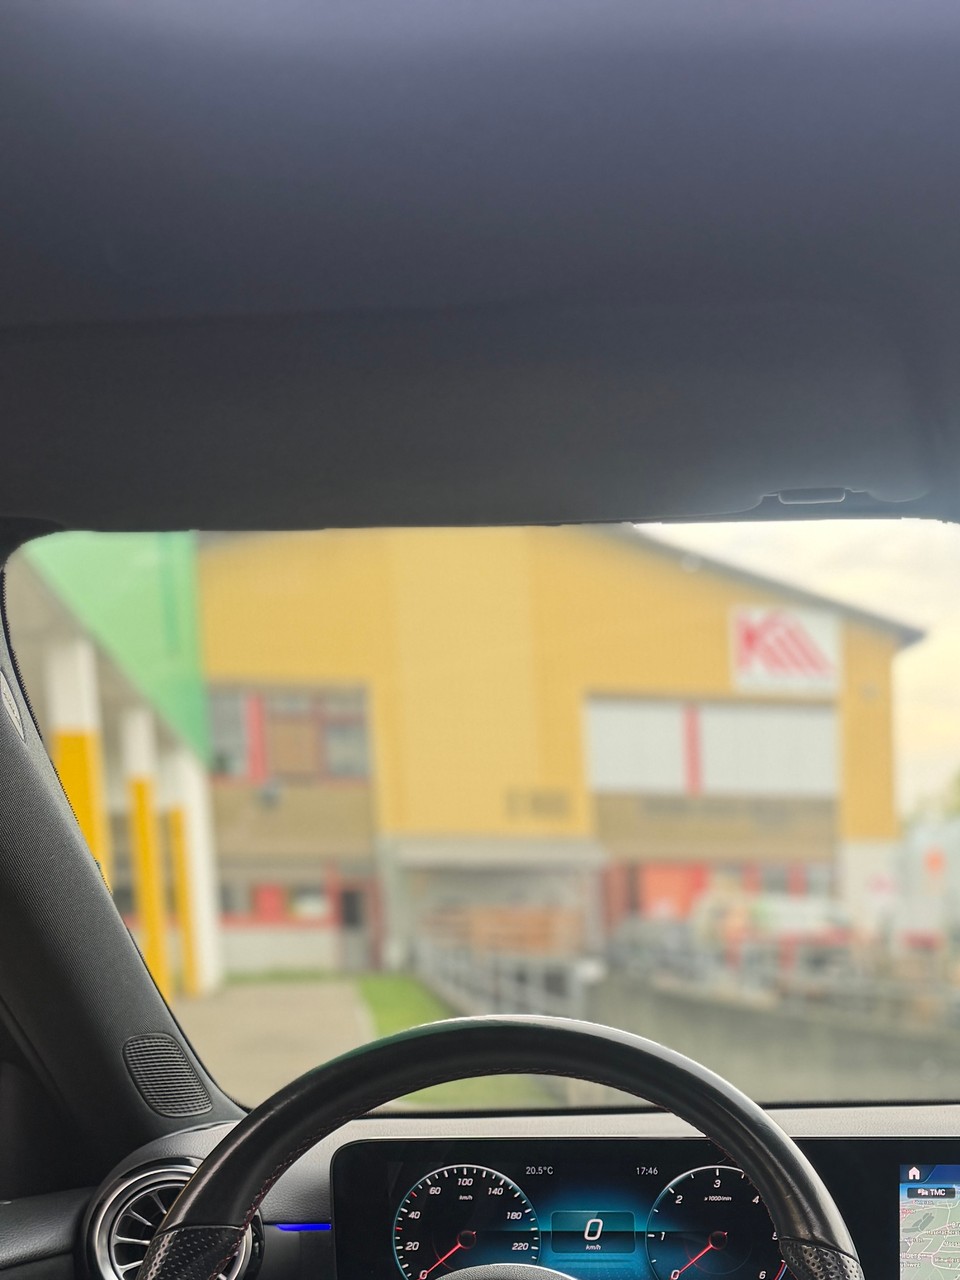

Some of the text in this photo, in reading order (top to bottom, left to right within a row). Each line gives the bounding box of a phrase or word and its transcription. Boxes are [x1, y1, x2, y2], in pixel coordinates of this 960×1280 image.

[526, 1166, 554, 1175] 20.5°C
[636, 1167, 659, 1175] 17:46
[457, 1178, 473, 1186] 100
[714, 1179, 721, 1188] 3
[429, 1187, 441, 1195] 60
[488, 1187, 503, 1195] 140
[675, 1195, 683, 1204] 2
[752, 1195, 760, 1204] 4
[408, 1211, 420, 1219] 40
[506, 1212, 522, 1220] 180
[584, 1218, 603, 1241] 0
[660, 1231, 666, 1241] 1
[772, 1232, 778, 1241] 5
[405, 1242, 419, 1250] 20
[512, 1243, 529, 1251] 220
[419, 1270, 428, 1280] 0
[671, 1269, 679, 1280] 0
[759, 1270, 767, 1280] 6
